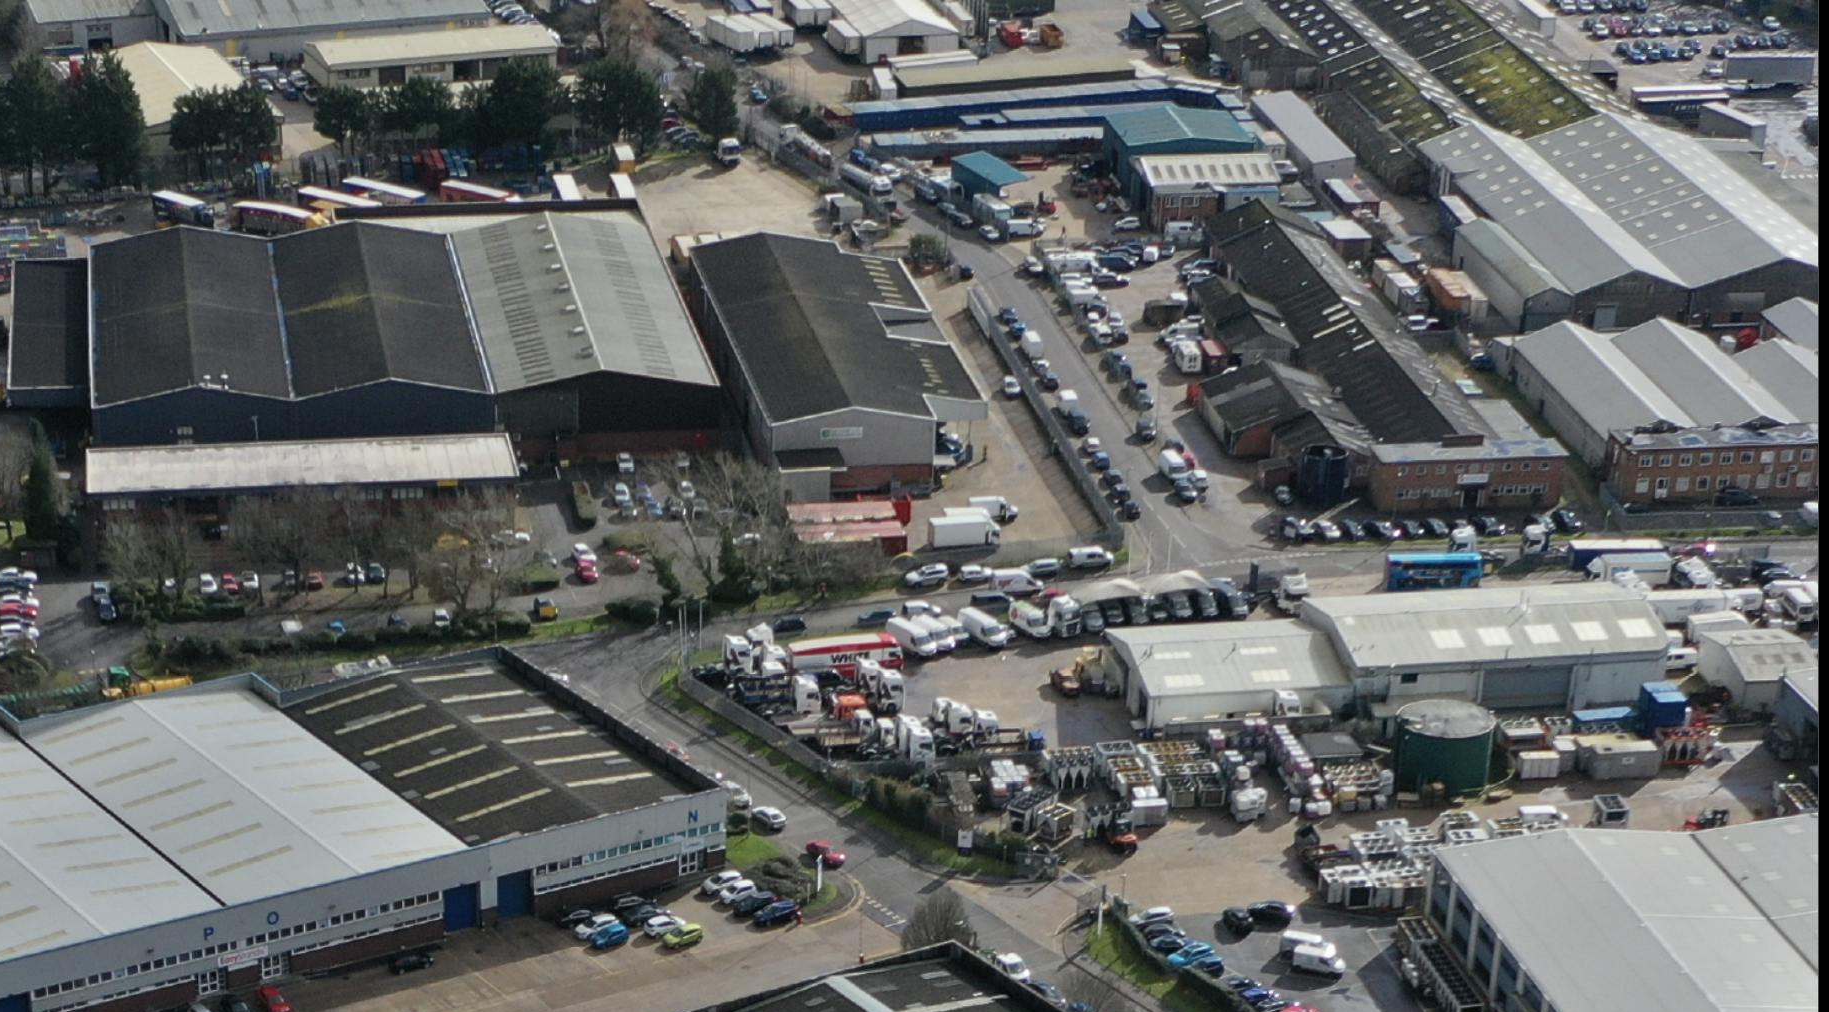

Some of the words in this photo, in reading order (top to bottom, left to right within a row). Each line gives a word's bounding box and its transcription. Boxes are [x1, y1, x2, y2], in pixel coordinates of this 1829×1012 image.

[688, 810, 698, 824] N
[267, 911, 279, 925] O
[204, 927, 214, 940] P
